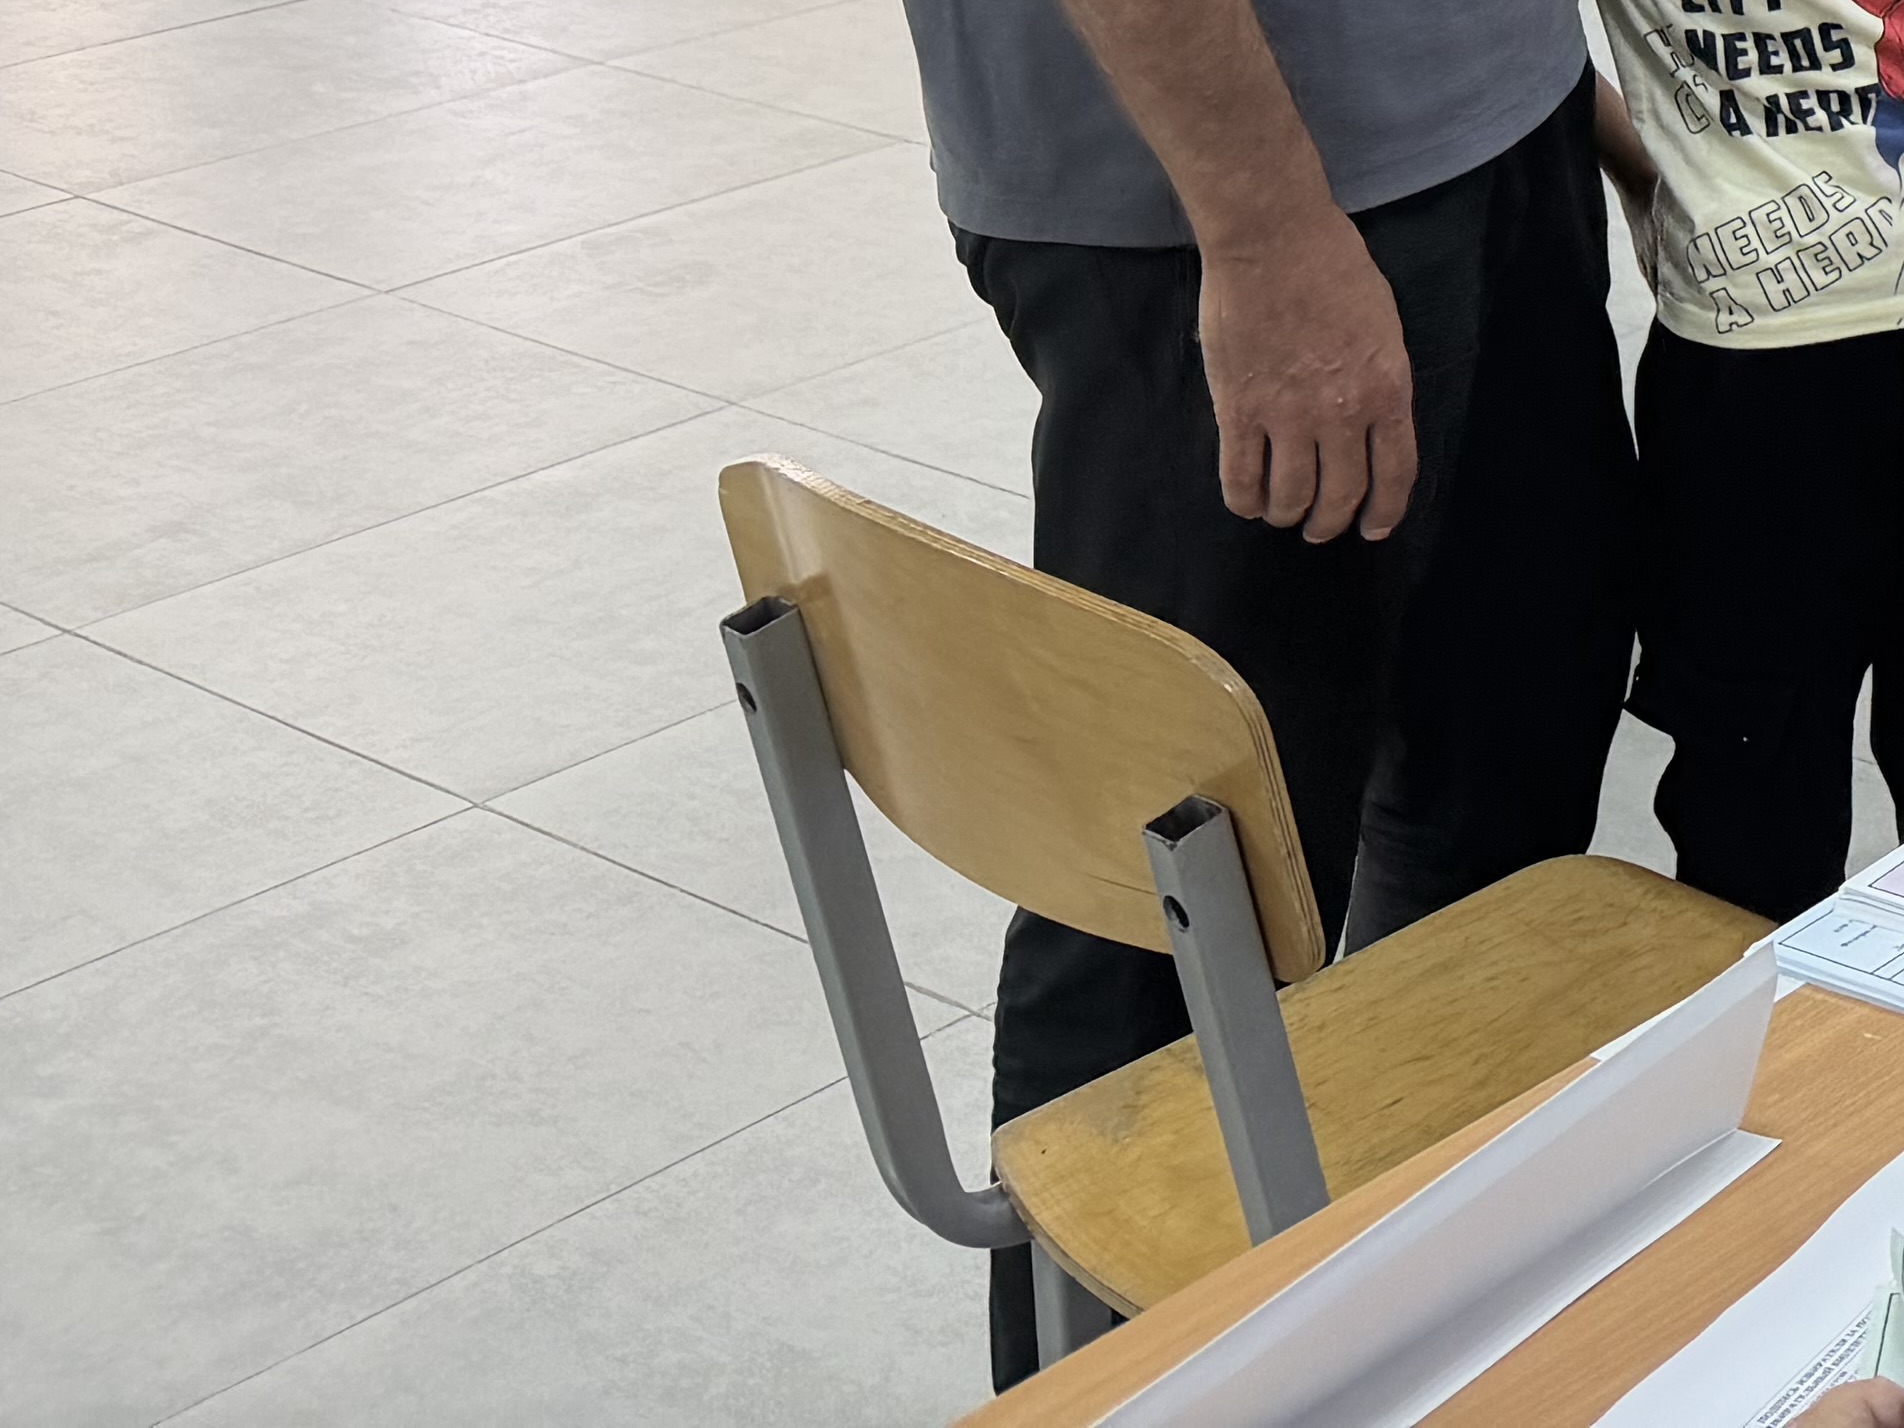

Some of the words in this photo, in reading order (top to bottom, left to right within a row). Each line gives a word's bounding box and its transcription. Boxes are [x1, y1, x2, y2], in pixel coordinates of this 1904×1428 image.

[1685, 22, 1856, 81] NEEDS
[1719, 89, 1754, 137] A
[1686, 170, 1857, 284] NEEDS
[1709, 287, 1755, 334] A
